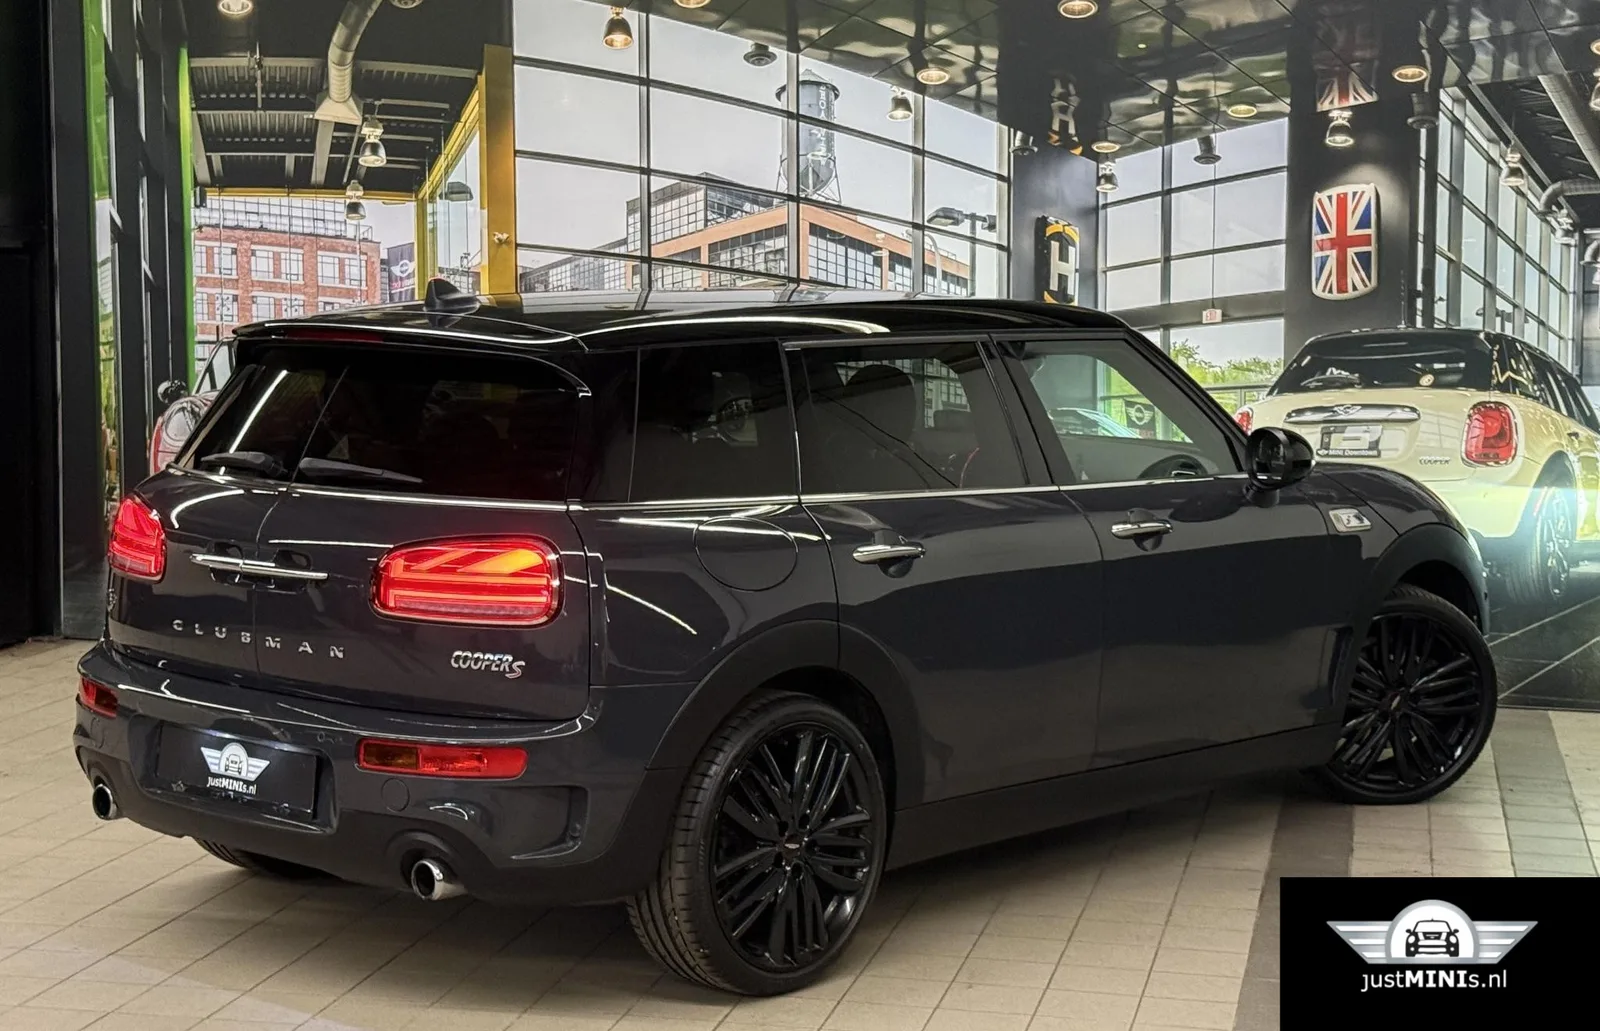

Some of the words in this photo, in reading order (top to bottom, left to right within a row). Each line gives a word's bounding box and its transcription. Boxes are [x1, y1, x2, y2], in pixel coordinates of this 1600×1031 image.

[1050, 240, 1075, 295] H
[1419, 456, 1450, 465] COOPER
[172, 619, 344, 659] CLUBMAN
[450, 650, 513, 672] COOPER
[505, 660, 526, 679] S
[206, 776, 257, 795] justMINIs.nl
